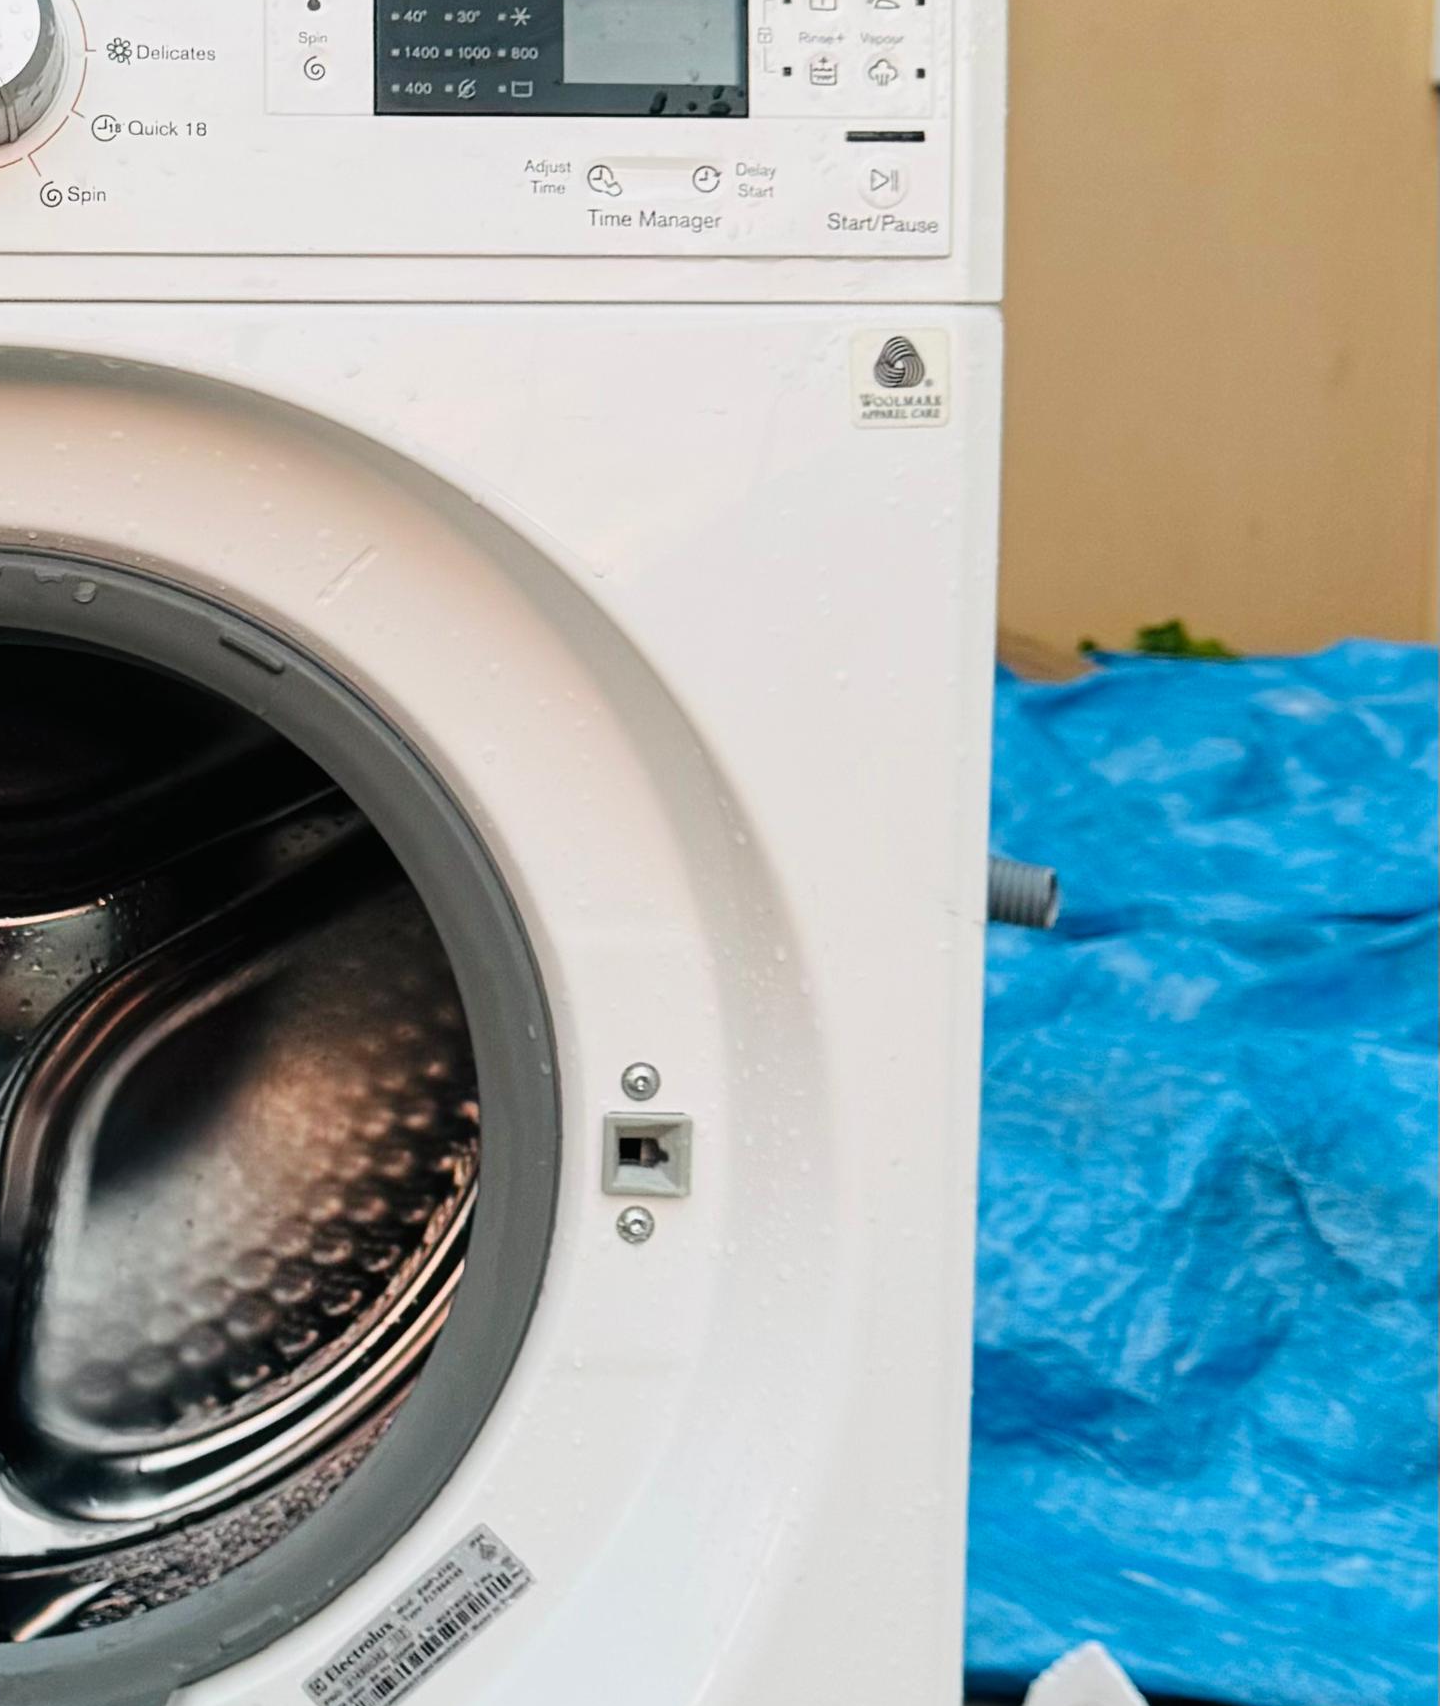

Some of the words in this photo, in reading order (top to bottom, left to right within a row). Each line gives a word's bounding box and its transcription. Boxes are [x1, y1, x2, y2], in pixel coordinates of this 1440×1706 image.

[298, 32, 328, 46] Spin
[136, 45, 216, 61] Delicates
[405, 46, 439, 59] 1400
[458, 47, 491, 59] 1000
[511, 47, 539, 60] 800
[405, 82, 432, 94] 400
[128, 120, 178, 137] Quick
[186, 123, 207, 136] 18
[524, 159, 571, 177] Adjust
[735, 163, 776, 181] Delay
[67, 186, 106, 205] Spin
[530, 180, 565, 194] Time
[738, 184, 774, 198] Start
[587, 209, 632, 227] Time
[639, 211, 722, 233] Manager
[827, 212, 939, 233] Start/Pause
[324, 1621, 394, 1683] Electrolux
